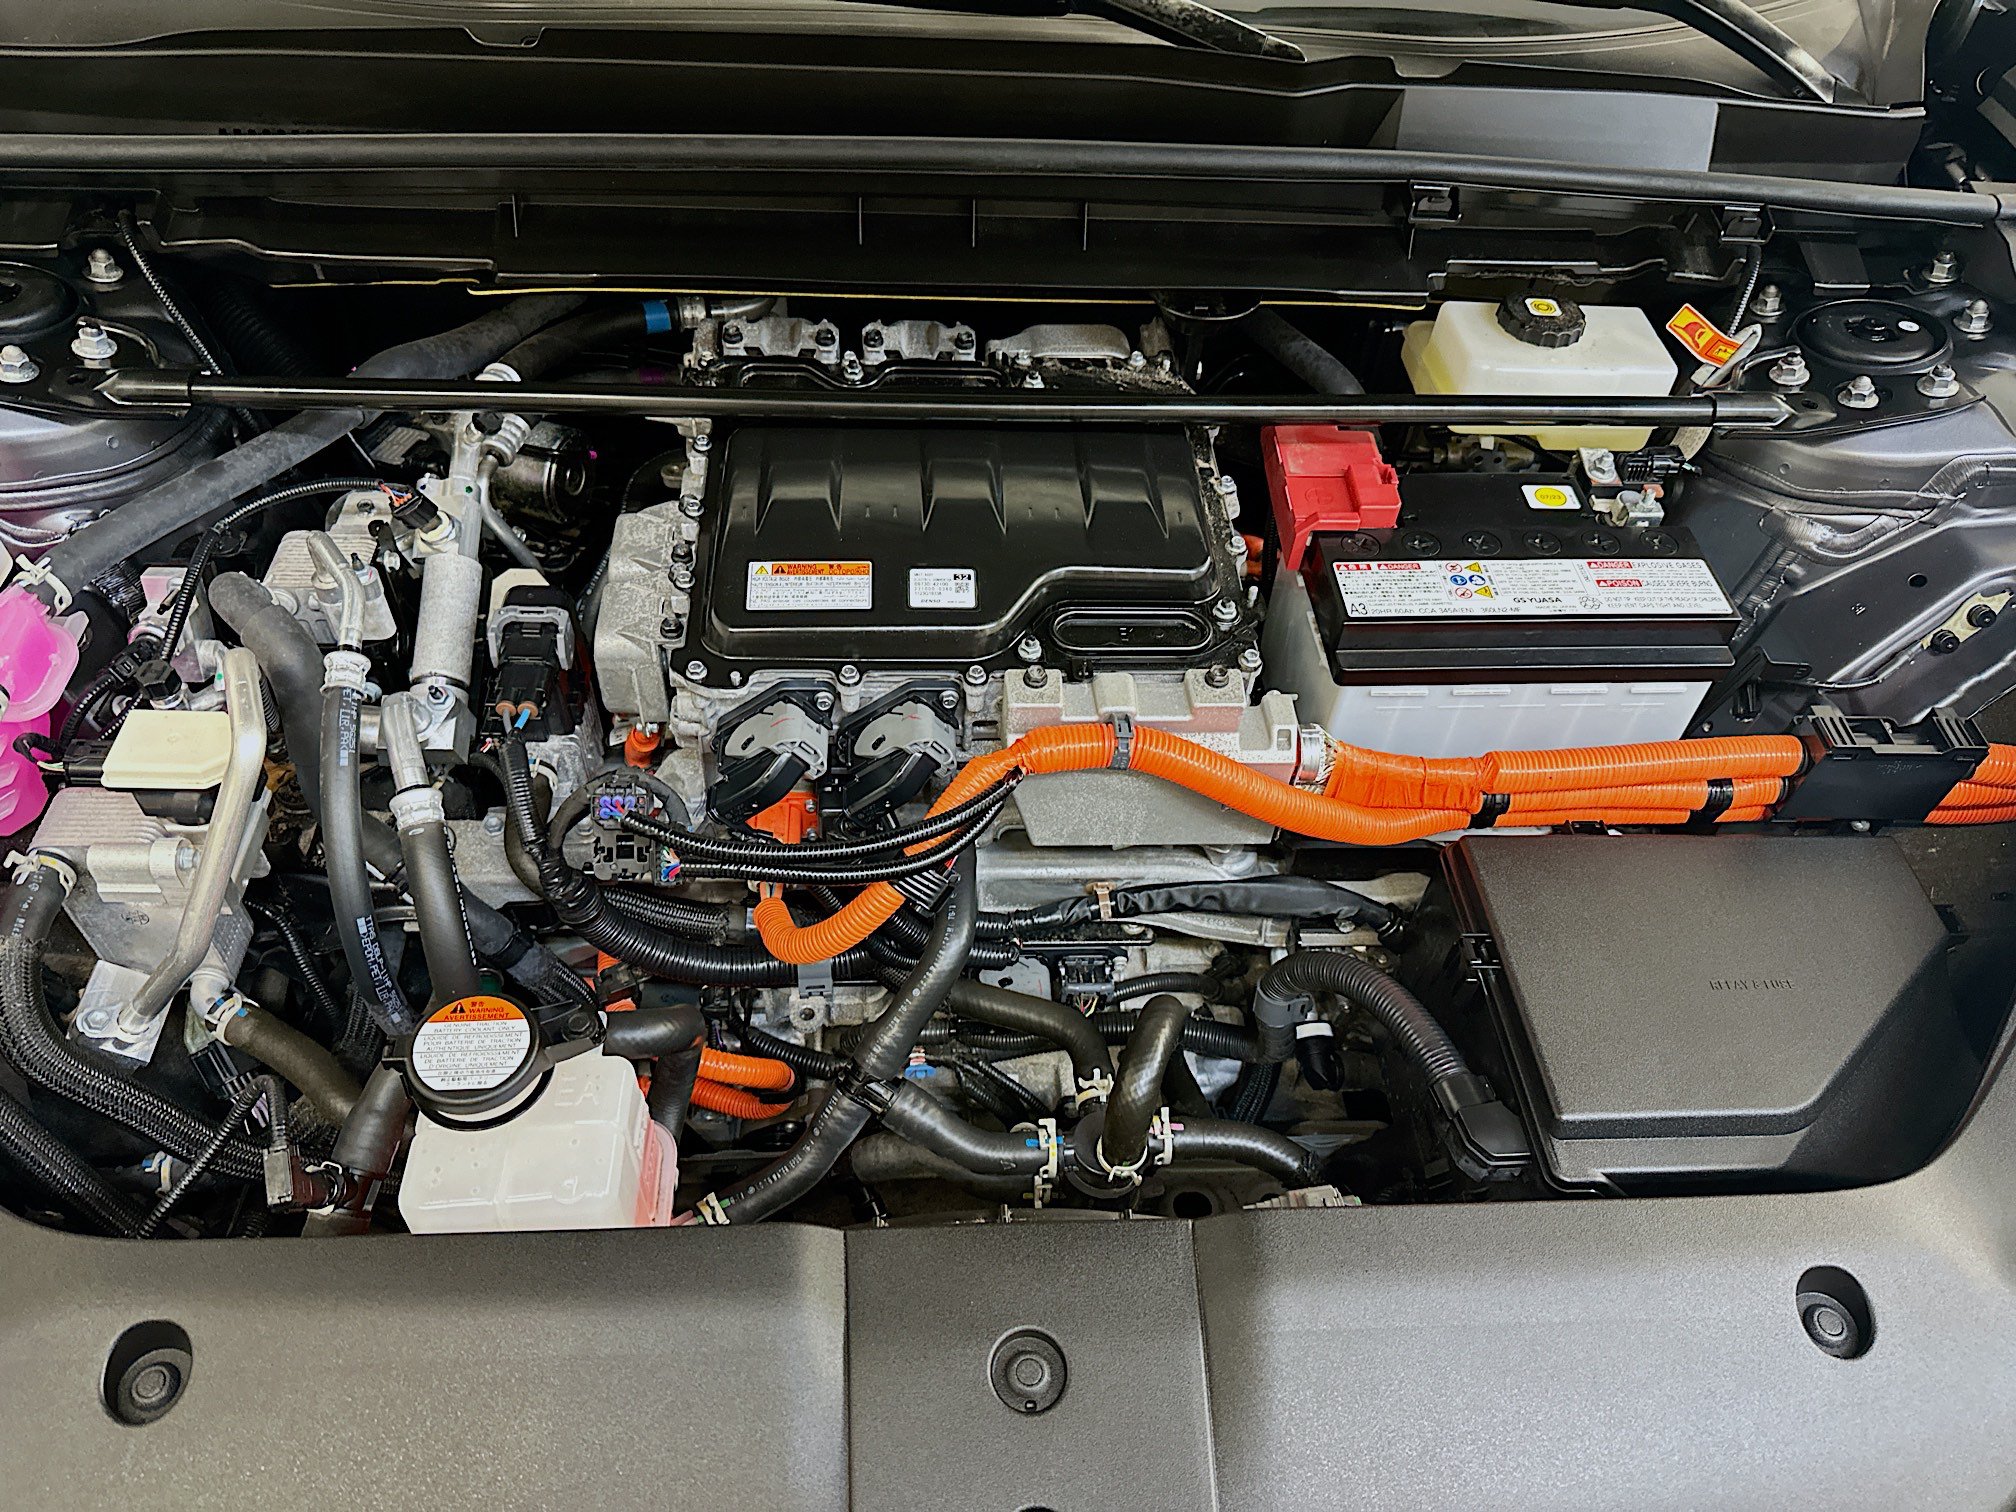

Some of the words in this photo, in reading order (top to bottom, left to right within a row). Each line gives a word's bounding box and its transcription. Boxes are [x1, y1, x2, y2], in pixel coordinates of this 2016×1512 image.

[1597, 561, 1631, 569] DANGER
[1632, 561, 1673, 569] EXPLOSIVE
[1675, 561, 1702, 569] GASES
[954, 573, 971, 581] 32
[1607, 579, 1640, 587] POISON
[1350, 602, 1368, 615] A3
[1708, 979, 1748, 990] RELAY
[443, 1012, 510, 1021] AVERTISSEMENT
